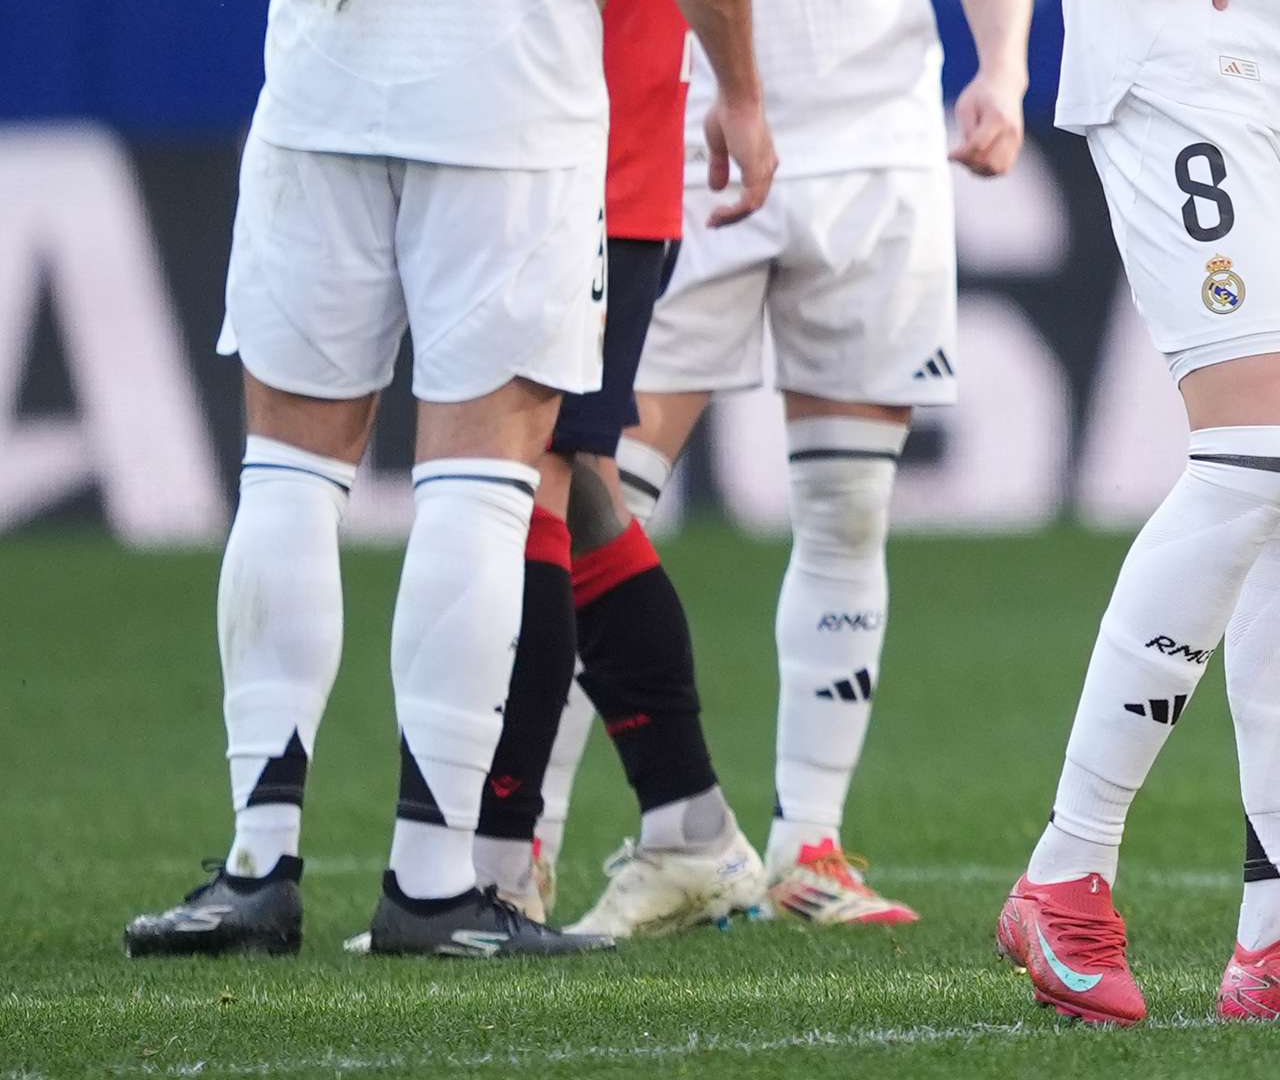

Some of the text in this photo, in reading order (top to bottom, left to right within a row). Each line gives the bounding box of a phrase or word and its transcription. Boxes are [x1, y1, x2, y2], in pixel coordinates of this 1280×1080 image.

[1174, 142, 1236, 243] 8
[817, 613, 880, 631] RMC
[1144, 635, 1215, 665] RMC
